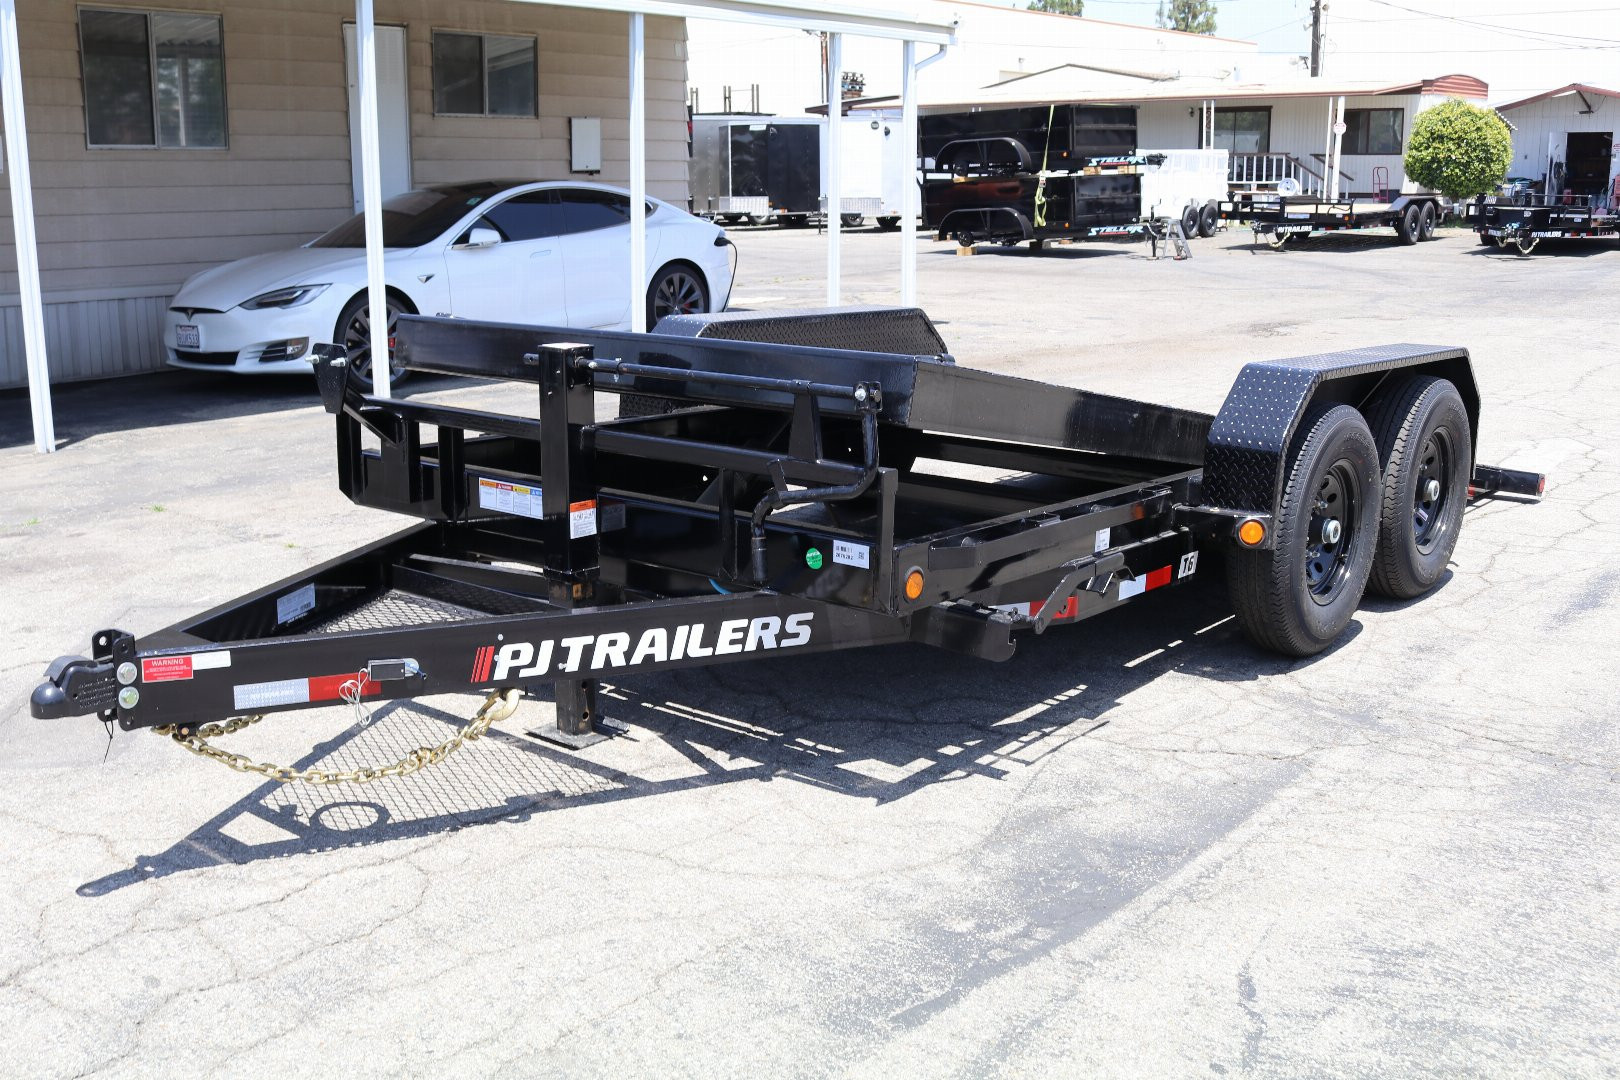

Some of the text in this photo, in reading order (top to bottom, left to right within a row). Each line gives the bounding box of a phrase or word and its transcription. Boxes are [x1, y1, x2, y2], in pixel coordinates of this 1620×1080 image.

[1088, 156, 1145, 167] STELLAR
[1087, 225, 1145, 237] STELLAR
[1284, 225, 1313, 233] TRAILERS
[1182, 555, 1195, 574] T6
[493, 612, 814, 681] PJ TRAILERS
[151, 658, 184, 667] WARNING
